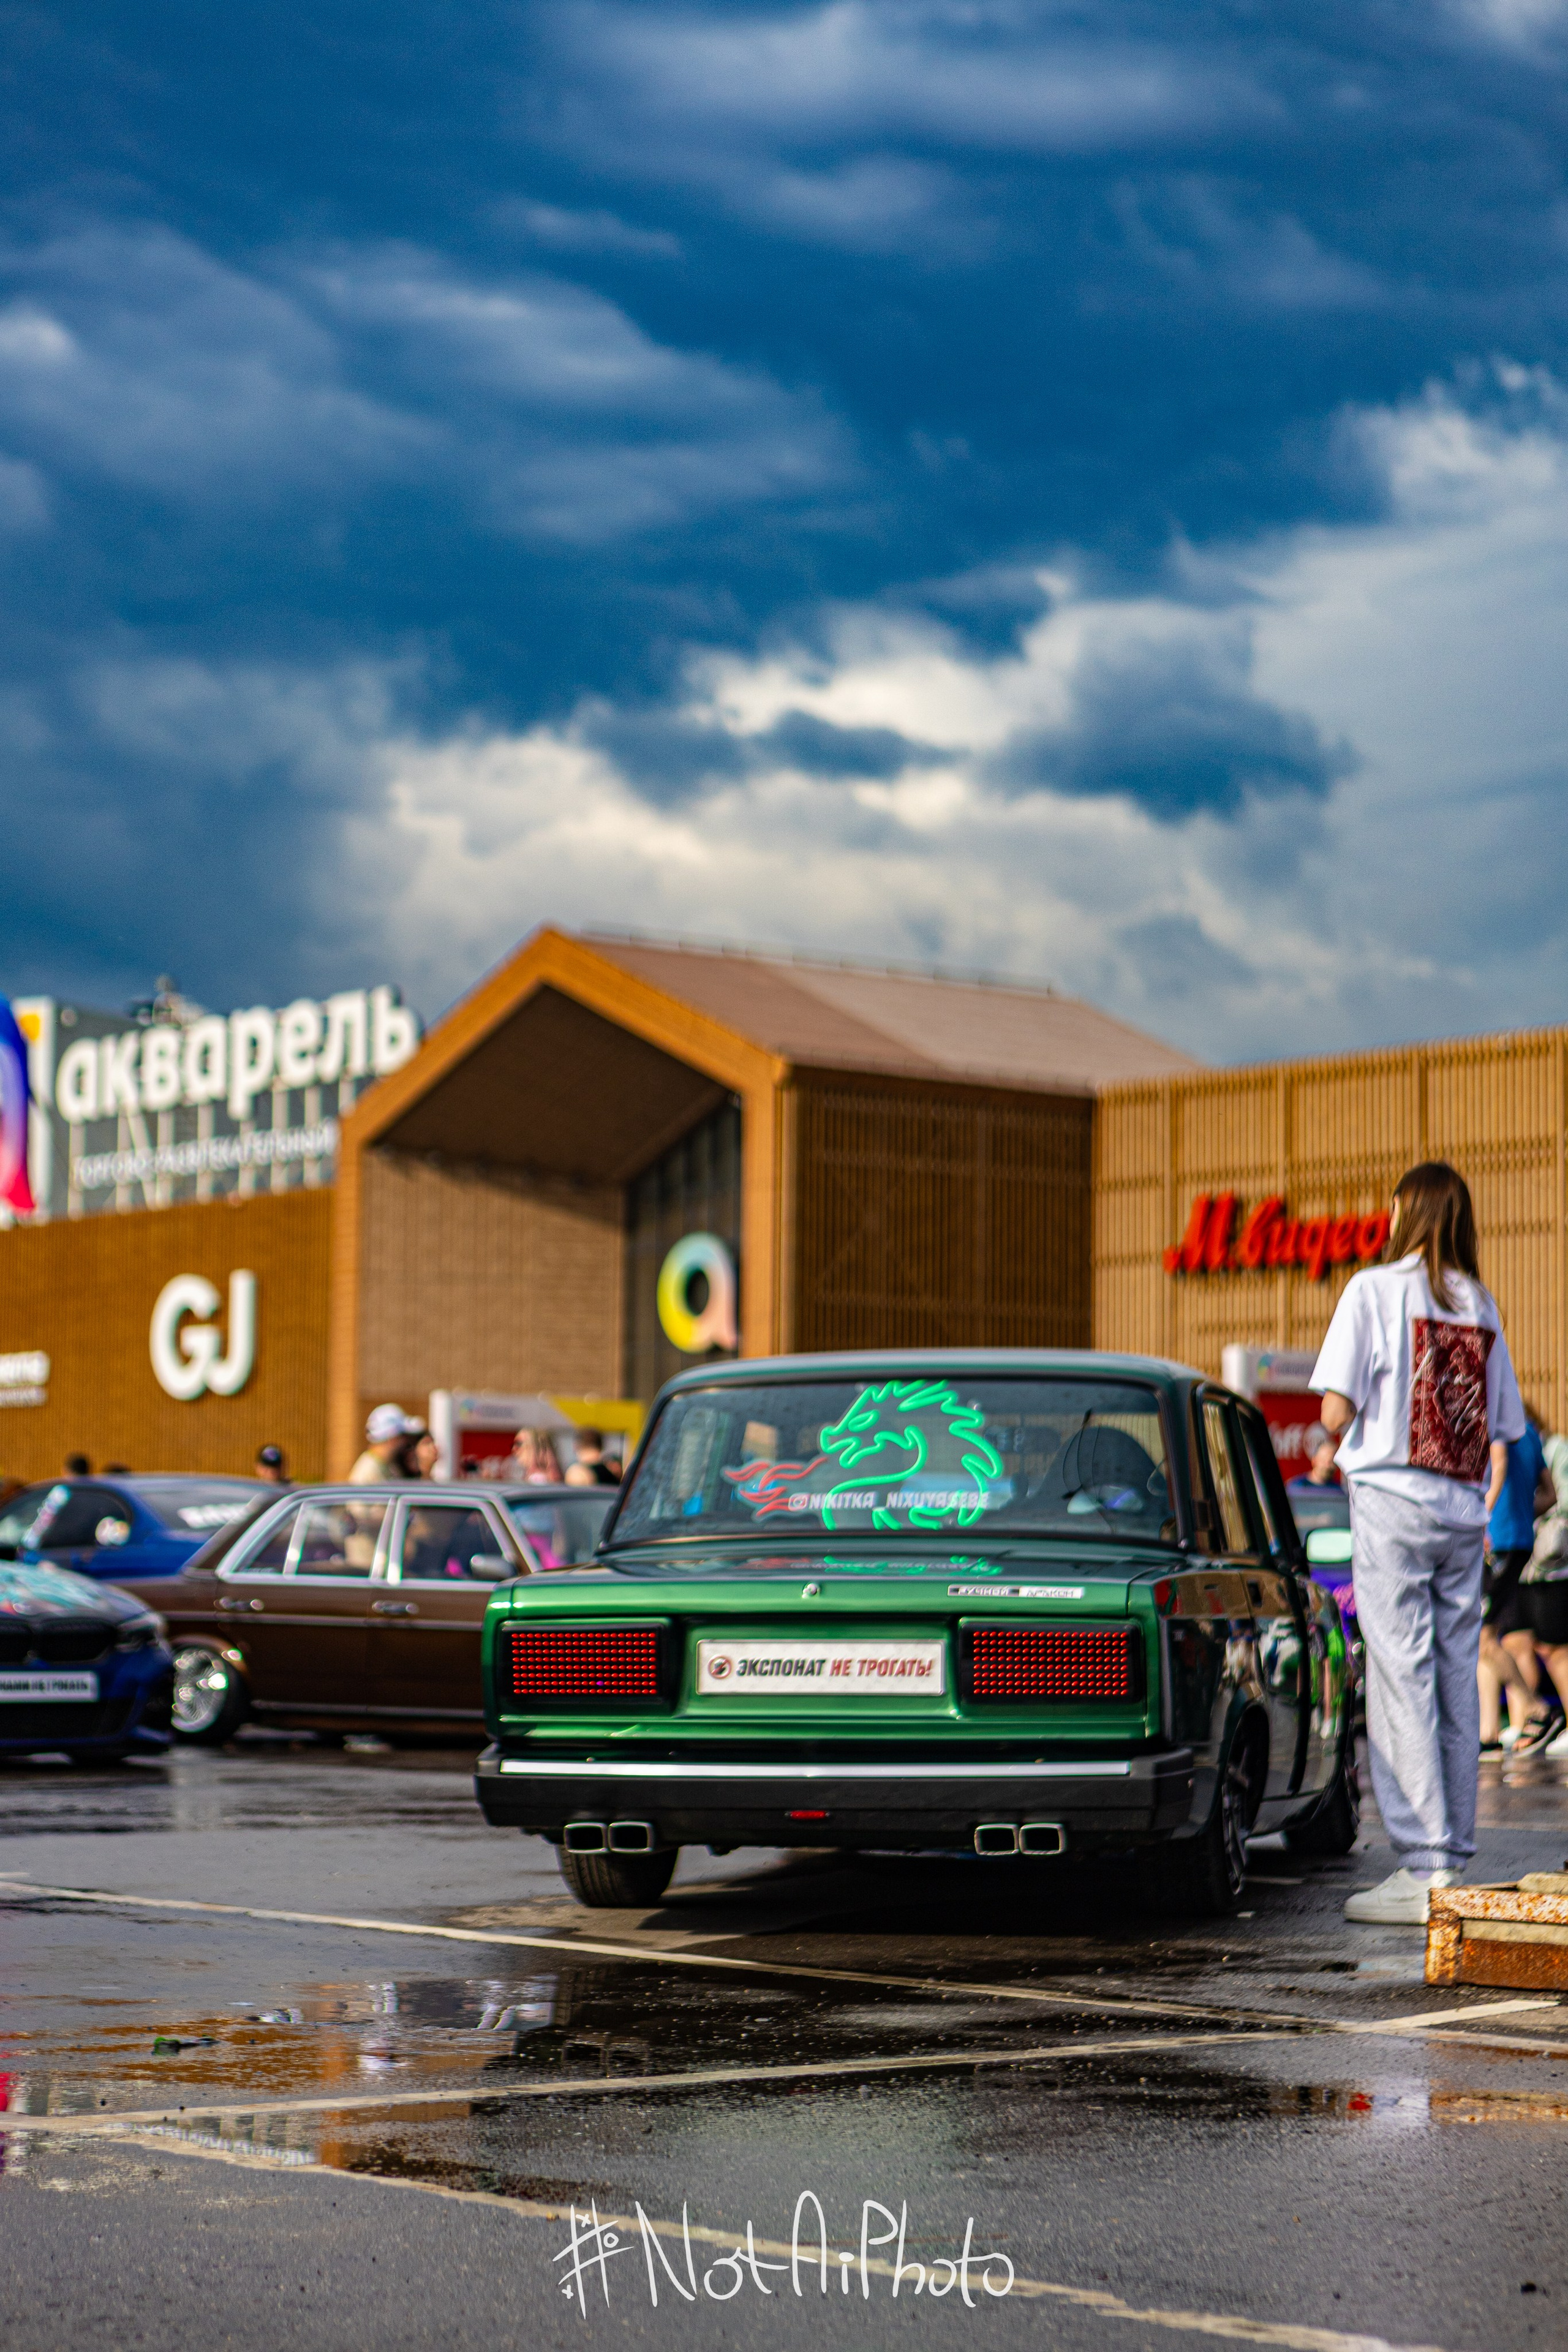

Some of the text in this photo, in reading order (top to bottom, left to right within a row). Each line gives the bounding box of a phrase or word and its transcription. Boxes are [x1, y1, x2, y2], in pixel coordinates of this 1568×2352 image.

[57, 983, 423, 1123] акварель
[149, 1267, 257, 1401] GJ
[736, 1658, 933, 1677] ЭКСПОНАТ НЕ ТРОГАТЬ!
